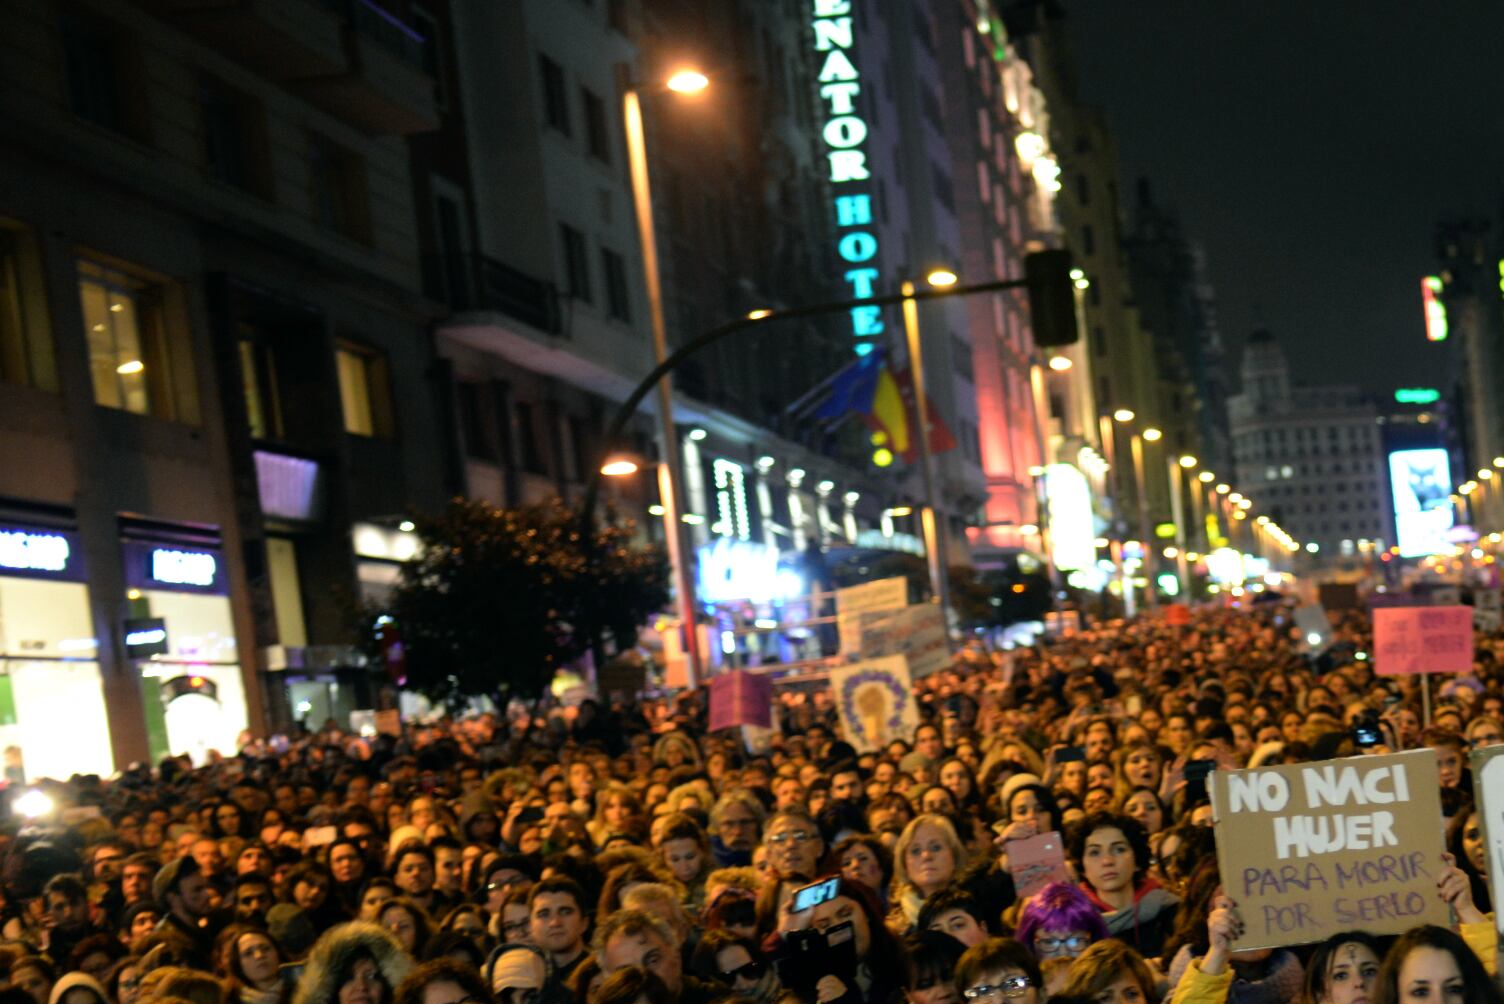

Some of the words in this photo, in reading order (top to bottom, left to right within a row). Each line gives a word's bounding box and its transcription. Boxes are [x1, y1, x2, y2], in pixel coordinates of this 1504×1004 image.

[834, 193, 885, 357] HOTE
[1227, 771, 1290, 813] NO
[1302, 764, 1410, 808] NACI
[1243, 862, 1328, 898] PARA
[1335, 851, 1432, 889] MORIR
[1261, 903, 1322, 935] POR
[1333, 891, 1426, 923] SERLO
